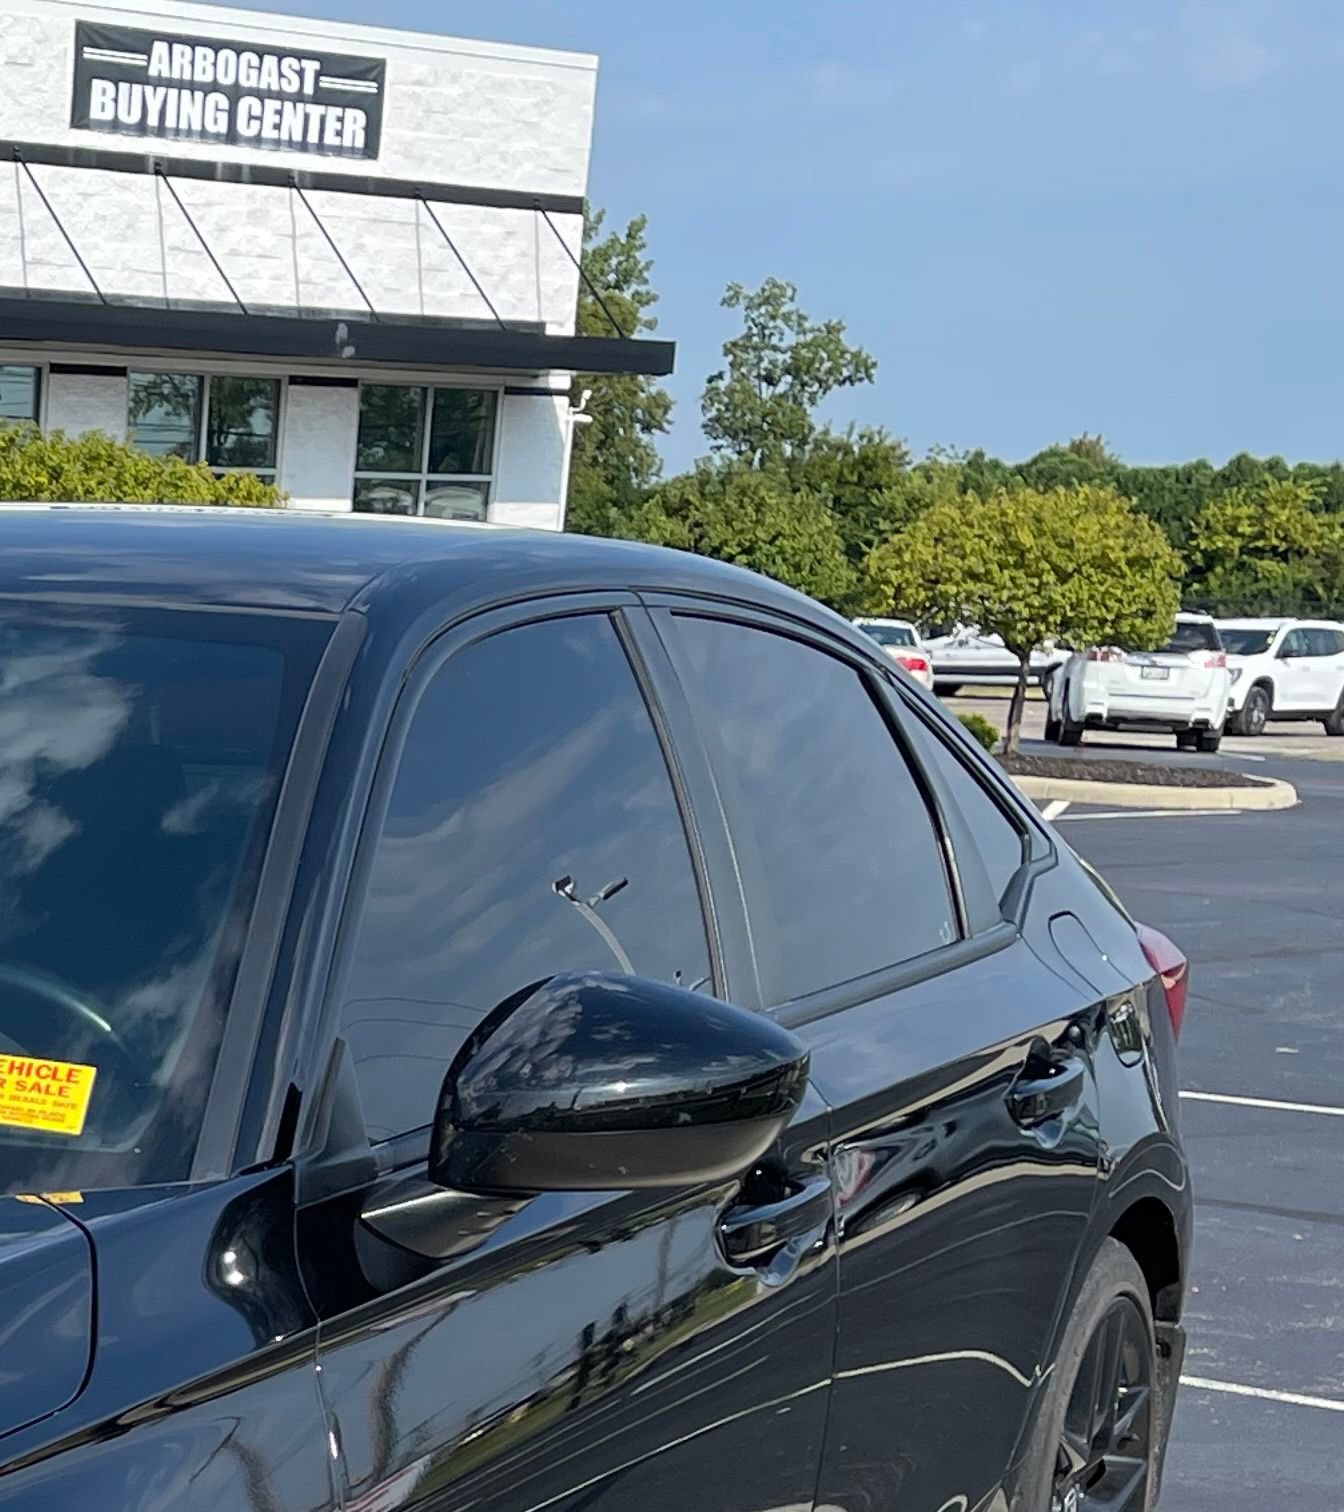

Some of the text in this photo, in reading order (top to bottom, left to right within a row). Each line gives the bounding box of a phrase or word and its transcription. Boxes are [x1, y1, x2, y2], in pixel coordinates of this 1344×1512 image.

[147, 40, 320, 95] ARBOGAST
[89, 78, 368, 148] BUYING CENTER
[15, 1080, 71, 1098] SALE
